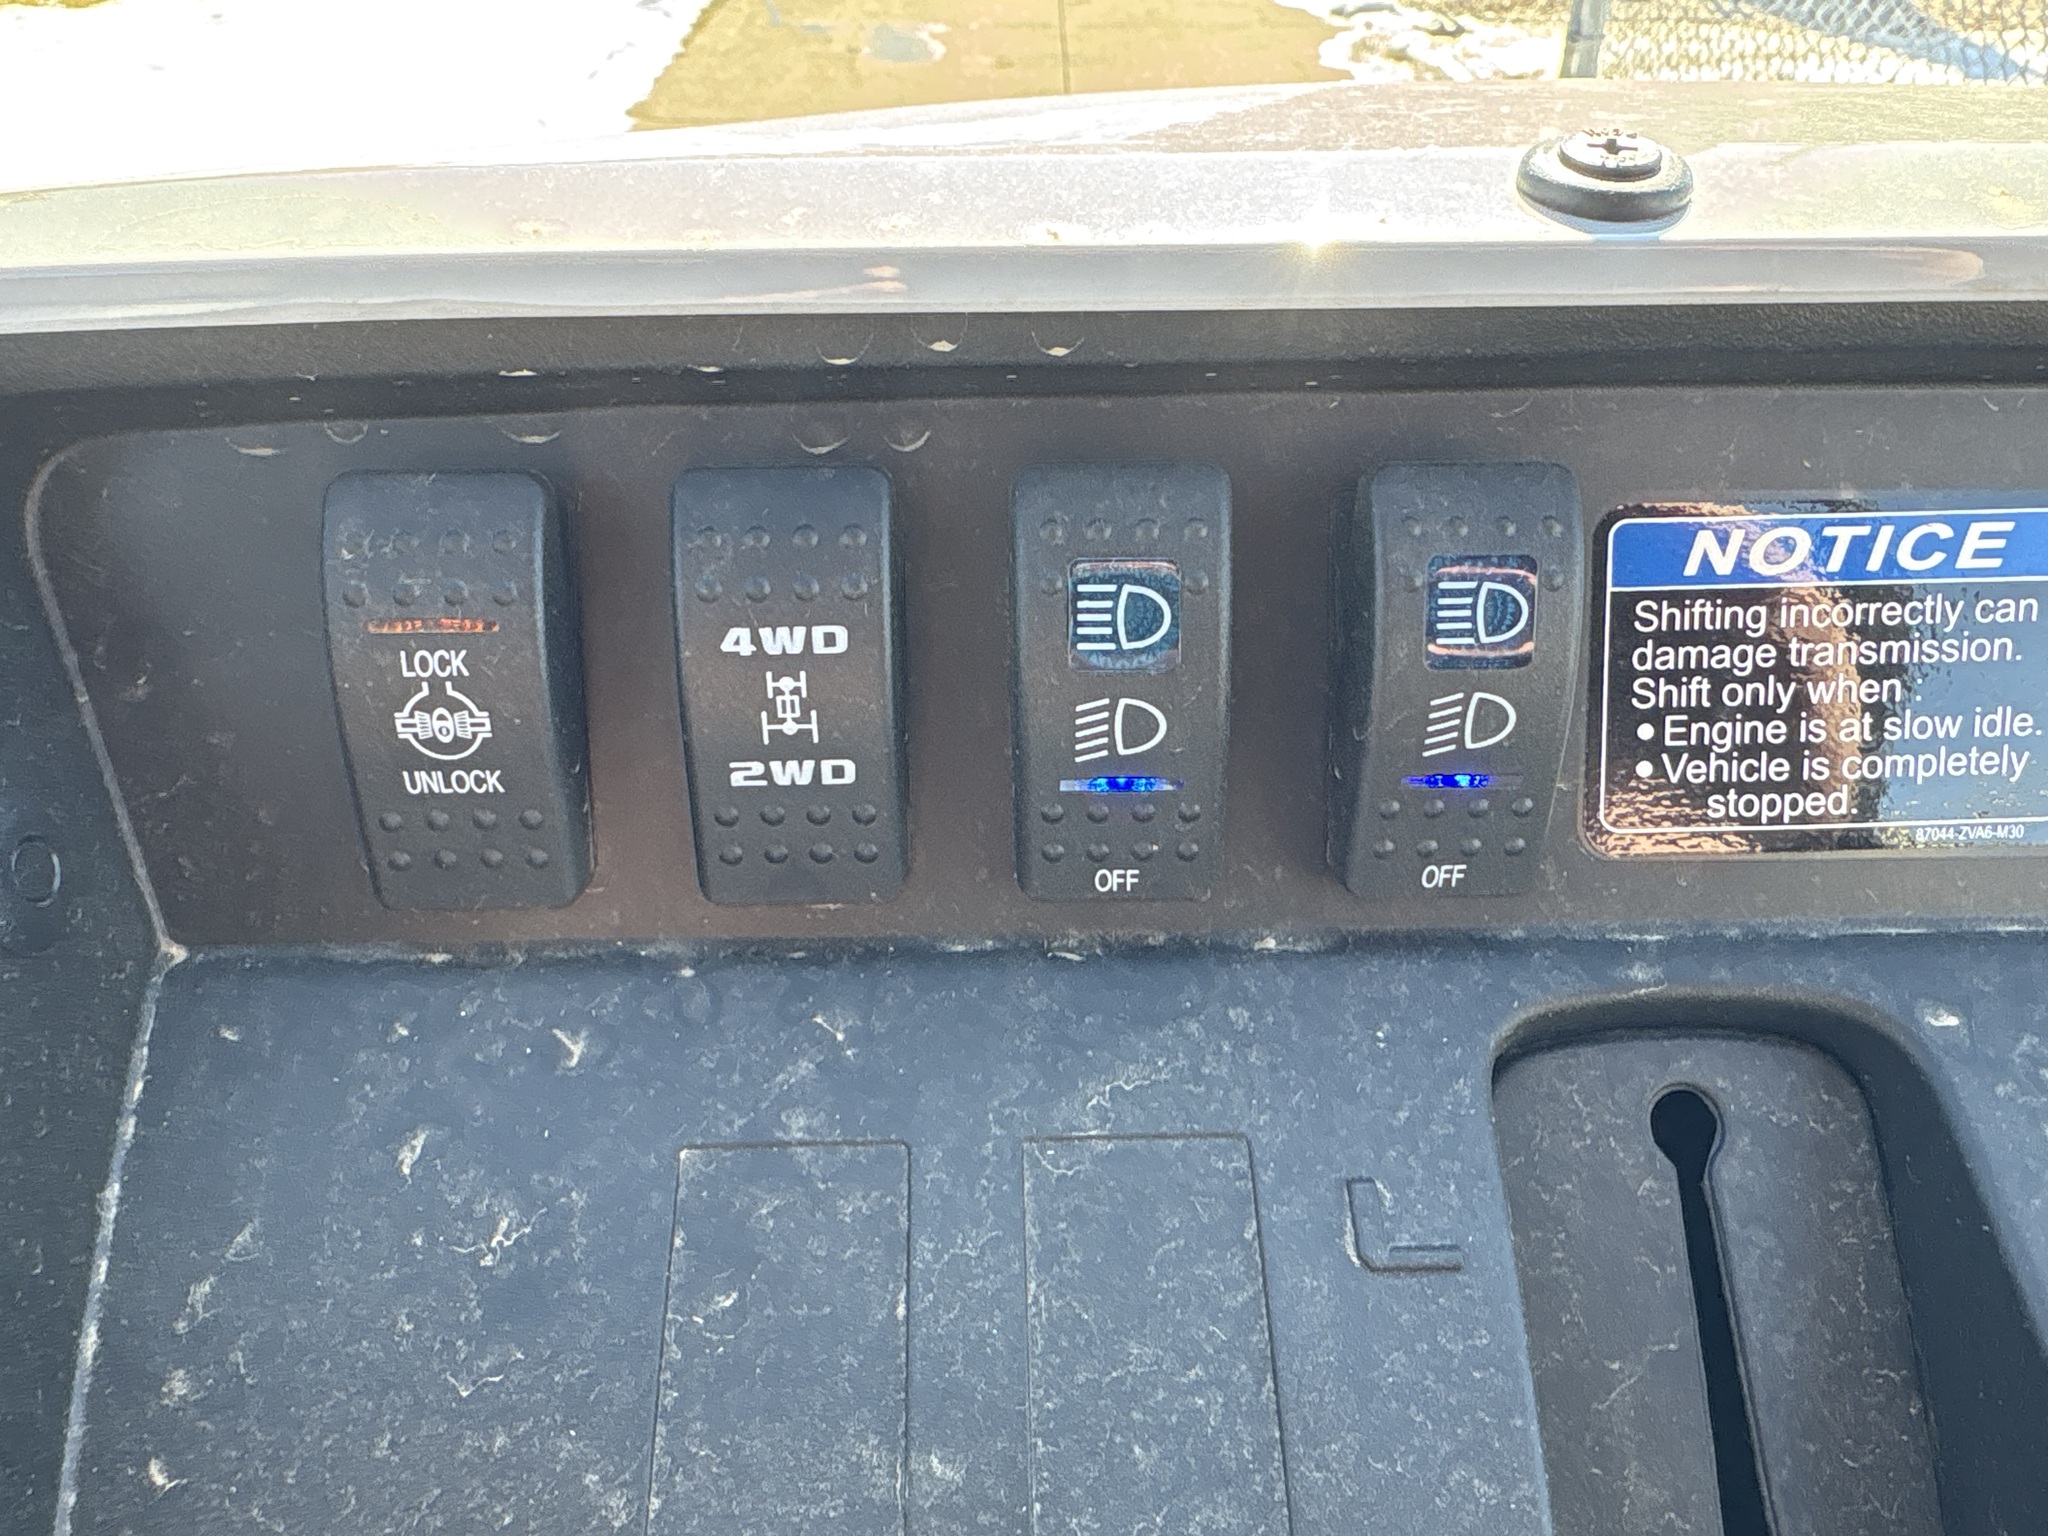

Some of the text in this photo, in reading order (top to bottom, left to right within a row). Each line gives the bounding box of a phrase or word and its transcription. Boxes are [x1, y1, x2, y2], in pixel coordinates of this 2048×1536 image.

[1683, 521, 2015, 577] NOTICE
[1633, 593, 2038, 637] Shifting incorrectly can
[720, 625, 849, 656] 4WD
[1631, 635, 2022, 677] damage transmission.
[400, 649, 469, 678] LOCK
[1631, 677, 1711, 709] Shift
[1721, 676, 1796, 713] only
[1808, 677, 1902, 703] when
[1663, 707, 2043, 753] Engine is at slow idle.
[402, 770, 505, 794] UNLOCK
[729, 759, 857, 787] 2WD
[1662, 744, 2029, 784] Vehicle is completely
[1706, 785, 1858, 824] stopped.
[1094, 869, 1140, 892] OFF
[1421, 864, 1467, 888] OFF
